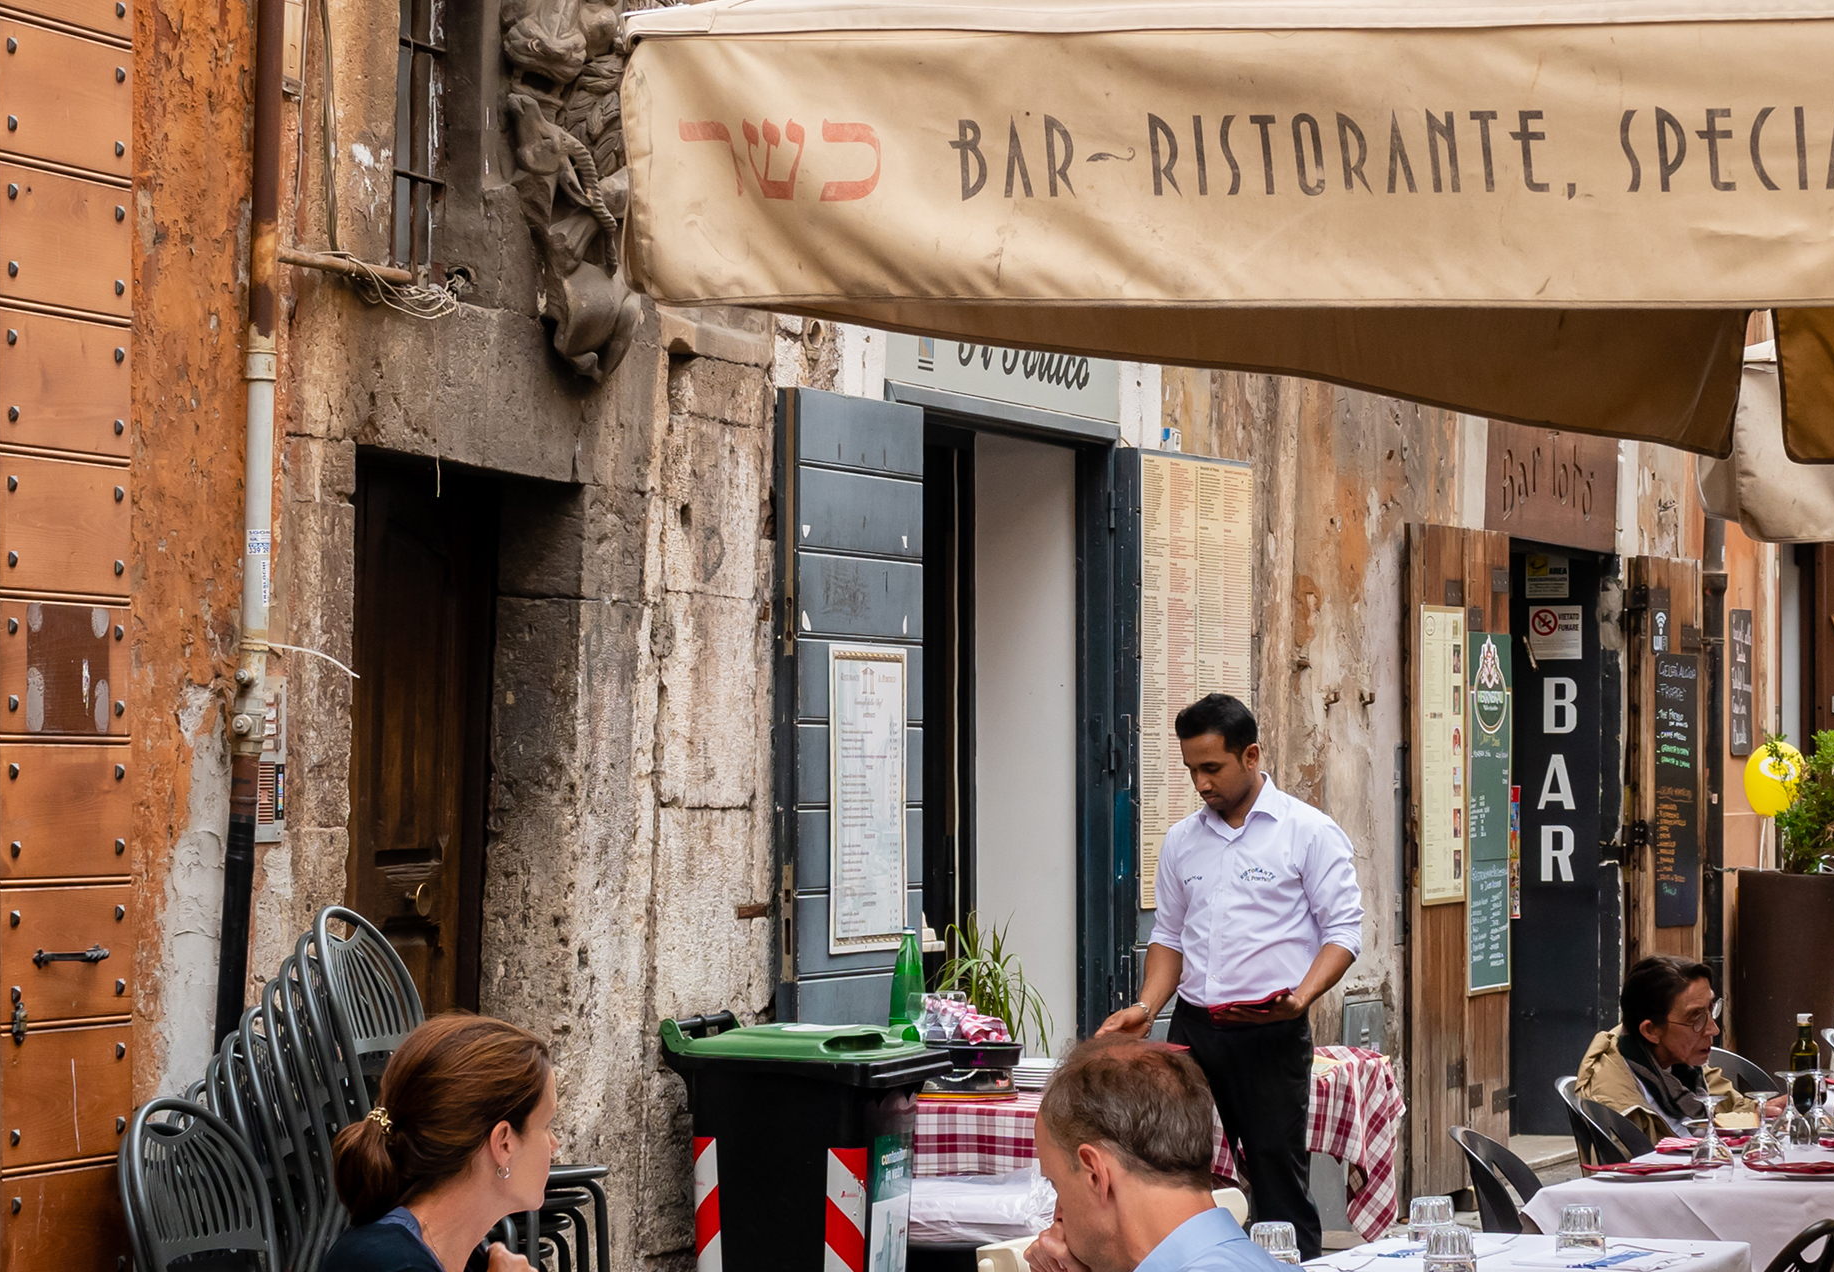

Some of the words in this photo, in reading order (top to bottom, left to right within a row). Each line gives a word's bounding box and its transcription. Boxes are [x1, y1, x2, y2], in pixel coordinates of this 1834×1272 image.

[678, 116, 882, 203] כשר
[1502, 447, 1541, 521] Bar
[1558, 613, 1579, 621] VIETATO
[1558, 623, 1579, 631] FUMARE
[1537, 677, 1578, 882] BAR
